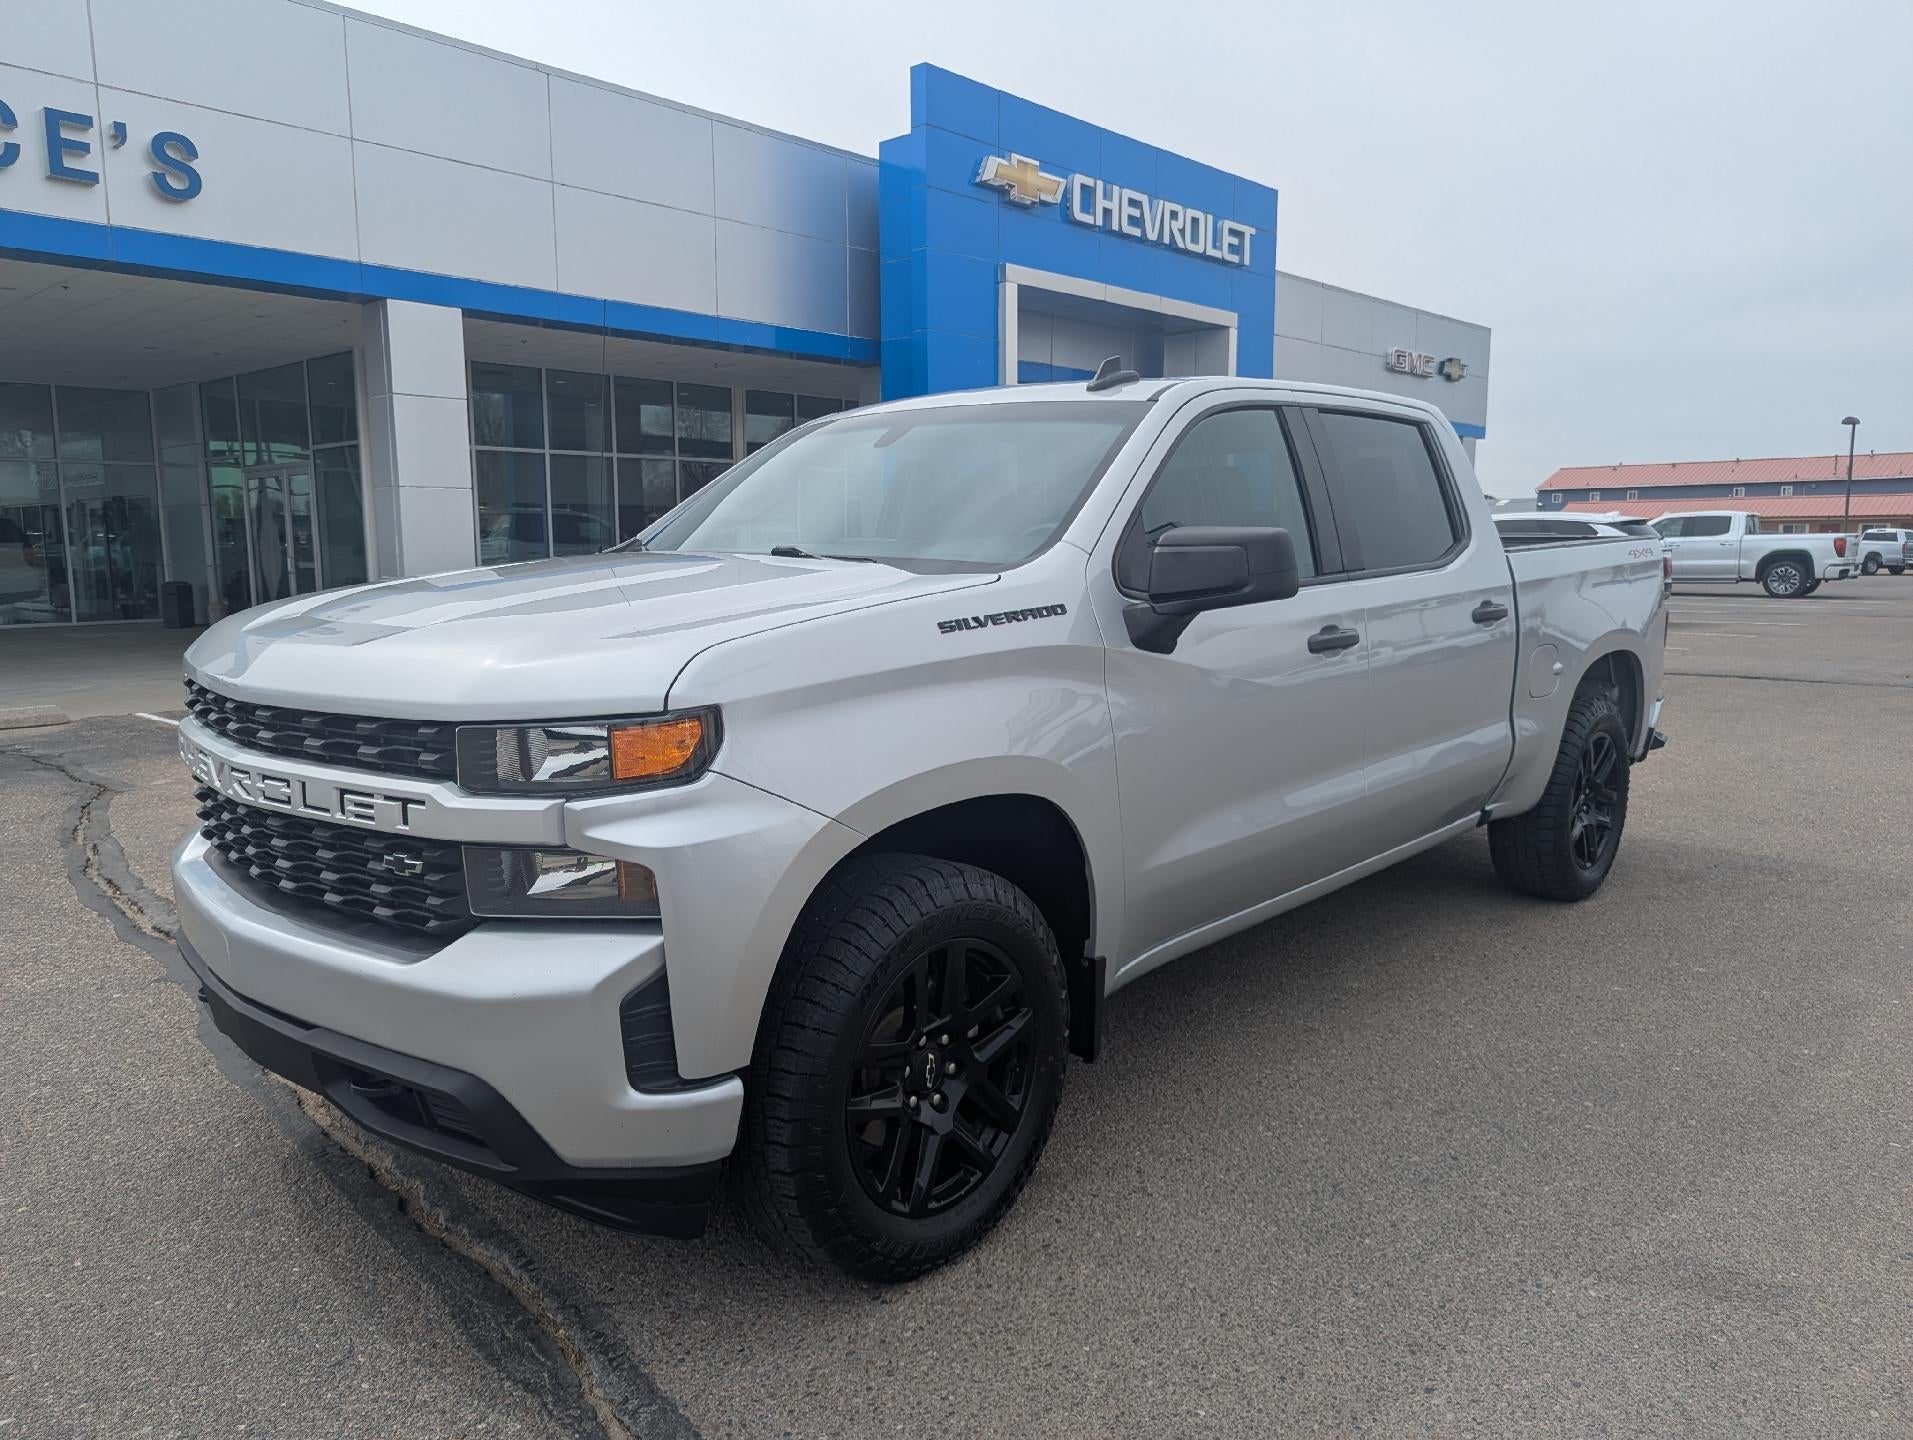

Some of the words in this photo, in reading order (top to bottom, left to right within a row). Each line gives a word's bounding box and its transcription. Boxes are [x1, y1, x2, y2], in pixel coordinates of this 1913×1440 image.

[1067, 173, 1256, 266] CHEVROLET
[1389, 348, 1435, 377] GMC
[936, 603, 1068, 635] SILVERADO
